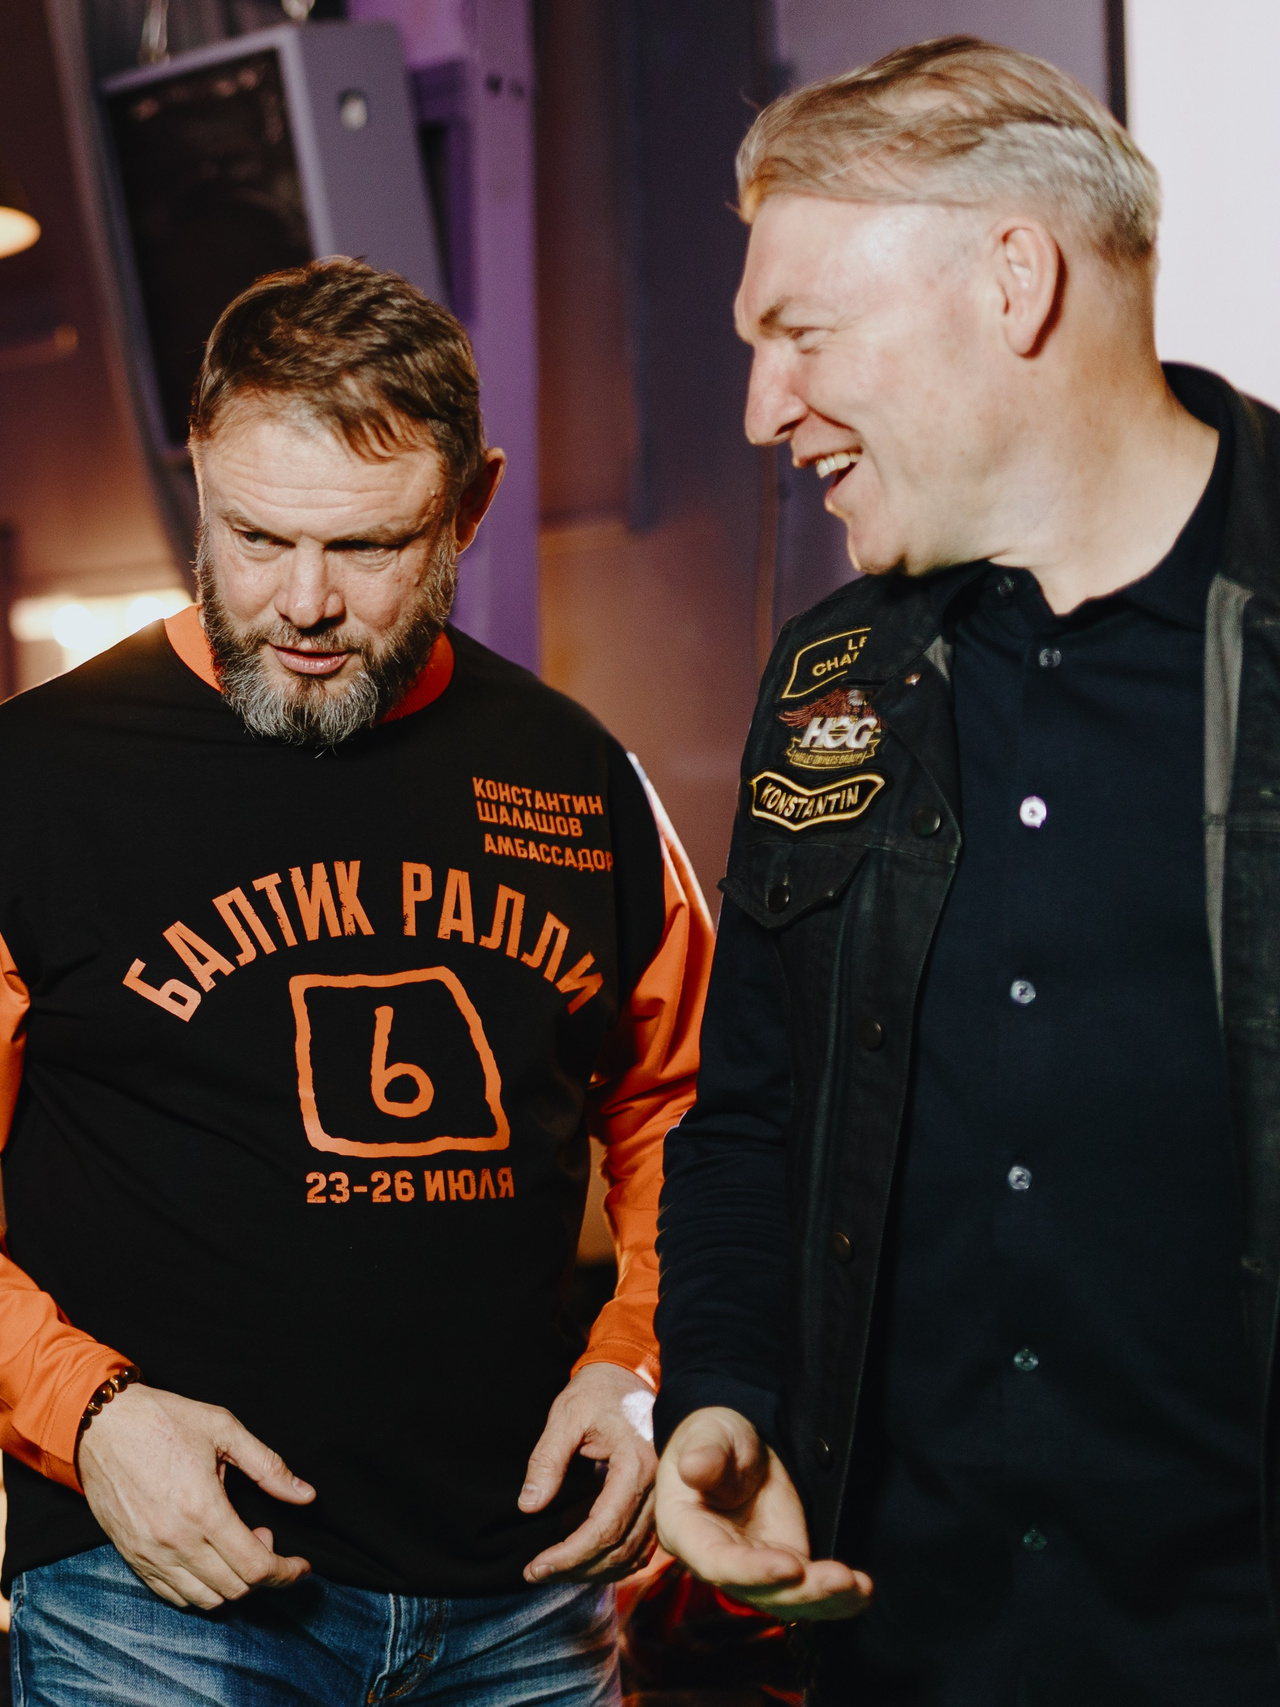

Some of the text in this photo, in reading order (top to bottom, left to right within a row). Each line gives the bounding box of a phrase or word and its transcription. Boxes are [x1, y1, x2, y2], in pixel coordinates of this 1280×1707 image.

[472, 776, 604, 815] КОНСТАНТИН
[759, 783, 860, 818] KONSTANTIN
[476, 800, 583, 838] ШАЛАШОВ
[484, 832, 614, 872] АМБАССАДОР
[122, 860, 605, 1023] БАЛТИК РАЛЛИ
[371, 1005, 435, 1118] 6
[305, 1167, 515, 1204] 23-26 ИЮЛЯ
